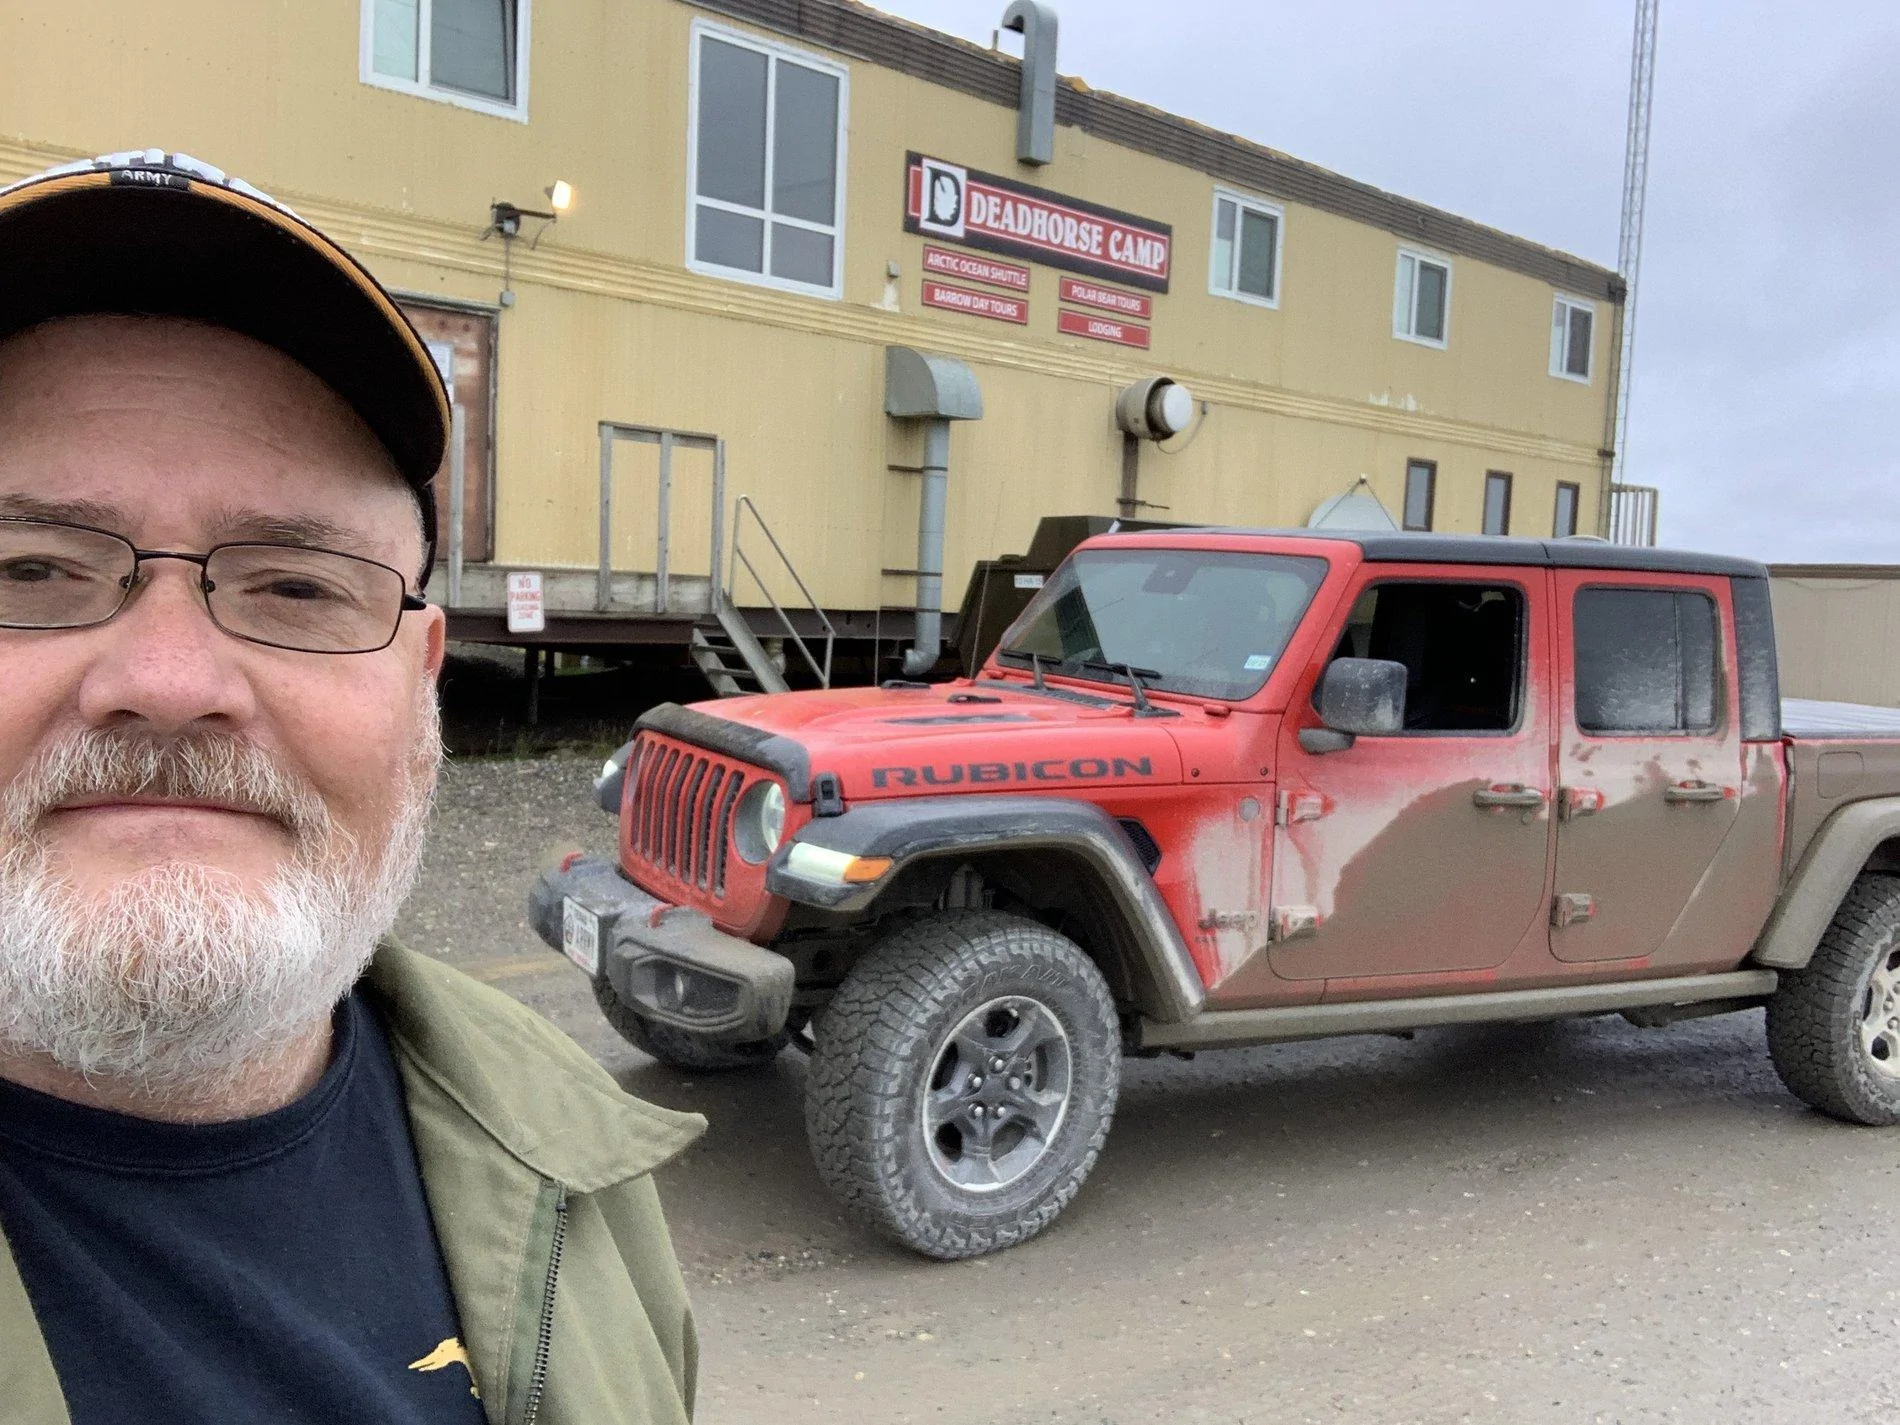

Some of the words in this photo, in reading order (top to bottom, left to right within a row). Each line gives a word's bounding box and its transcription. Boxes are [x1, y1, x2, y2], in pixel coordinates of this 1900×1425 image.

[121, 169, 172, 186] ARMY
[970, 191, 1103, 255] DEADHORSE
[1109, 230, 1165, 270] CAMP
[927, 252, 959, 271] ARCTIC
[960, 260, 989, 277] OCEAN
[991, 267, 1026, 286] SHUTTLE
[934, 288, 972, 307] BARROW
[972, 296, 990, 310] DAY
[990, 300, 1017, 316] TOURS
[1071, 284, 1097, 301] POLAR
[1097, 291, 1117, 305] BEAR
[1117, 296, 1141, 312] TOURS
[1088, 321, 1122, 338] LODGING
[518, 577, 532, 589] NO
[872, 757, 1153, 788] RUBICON
